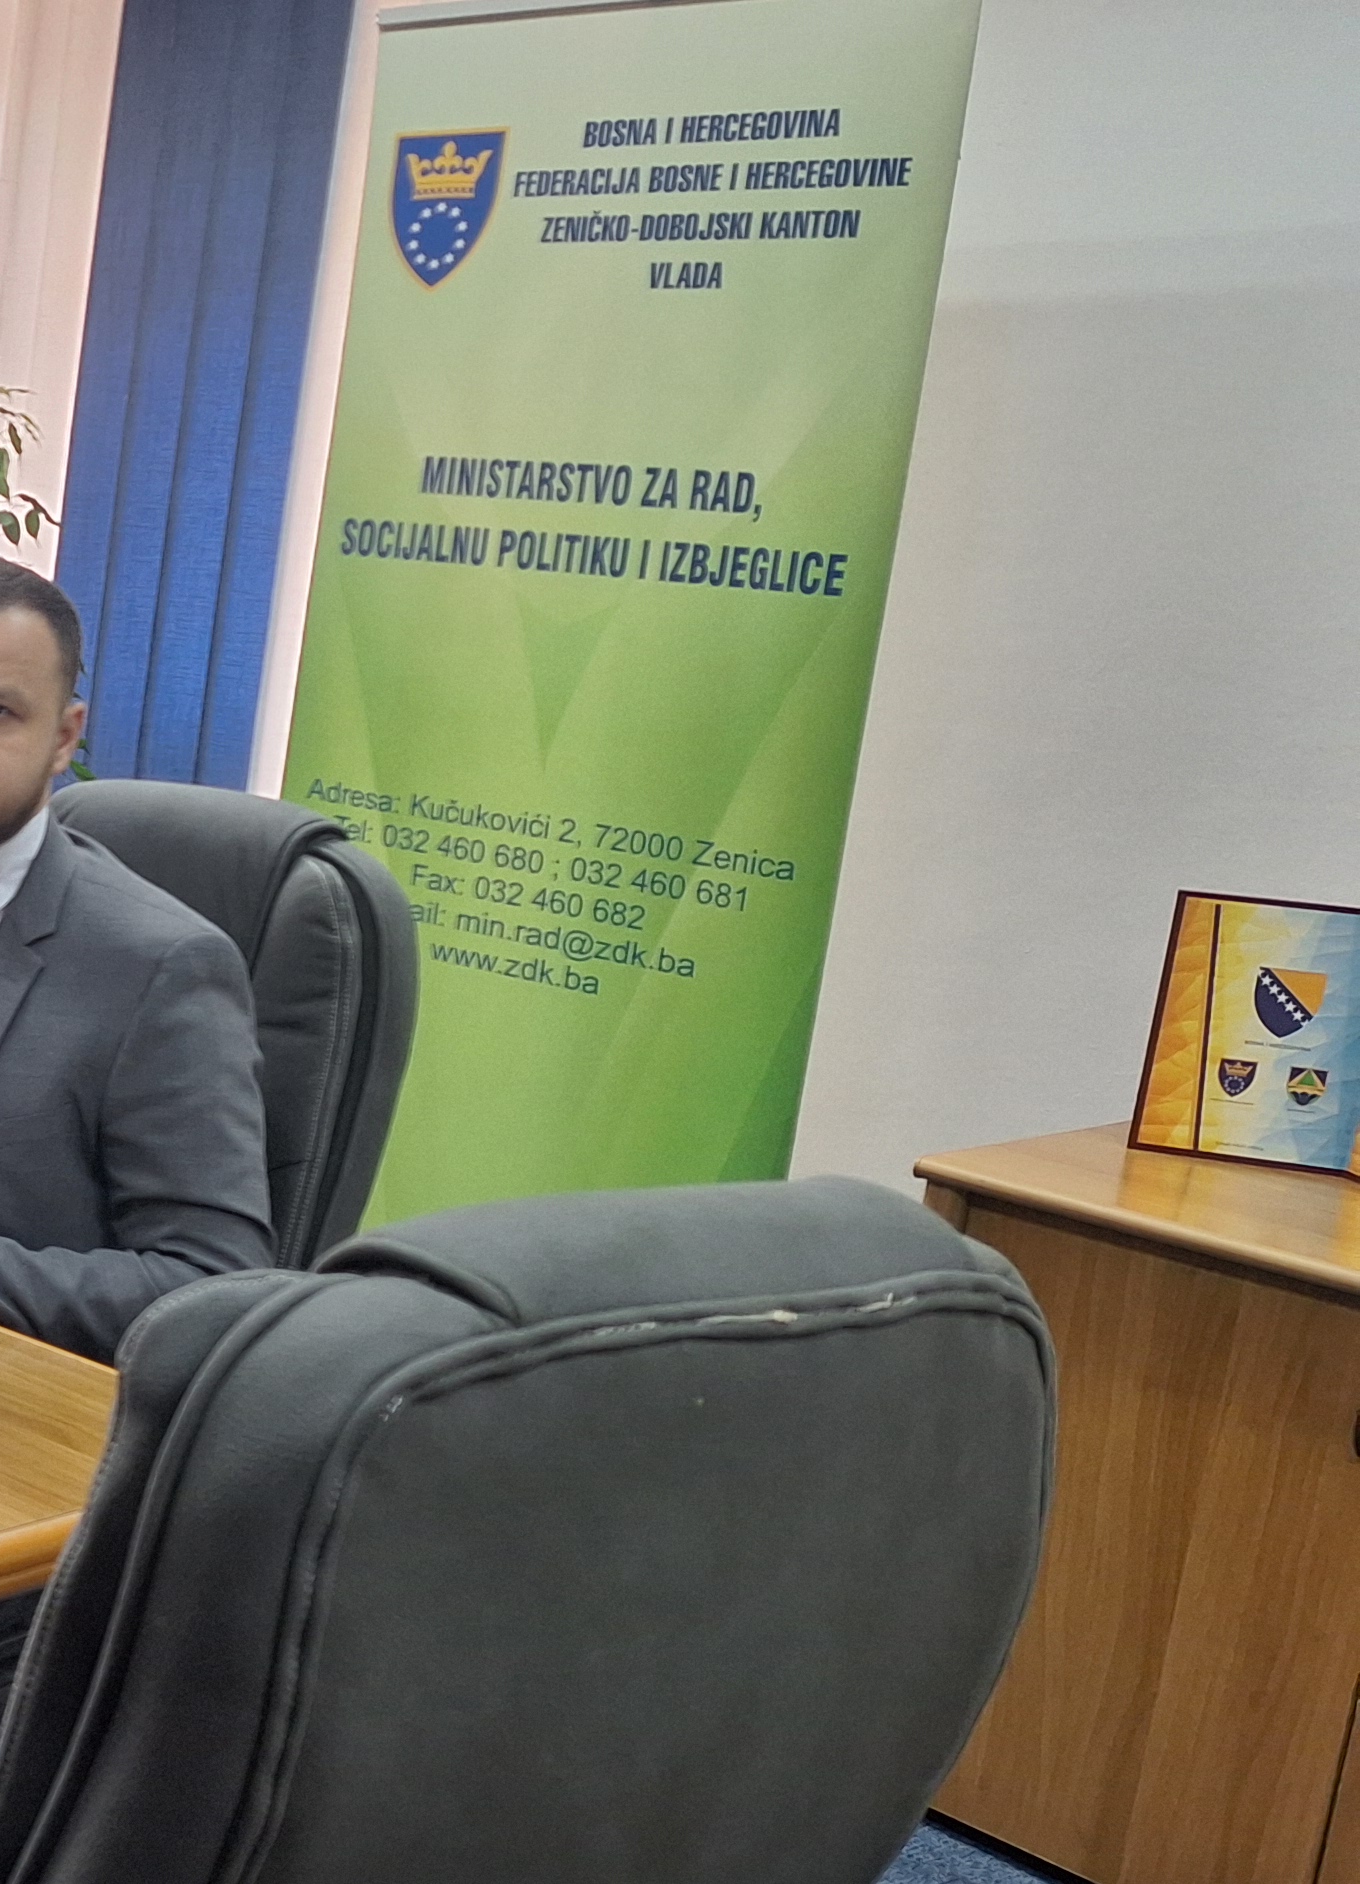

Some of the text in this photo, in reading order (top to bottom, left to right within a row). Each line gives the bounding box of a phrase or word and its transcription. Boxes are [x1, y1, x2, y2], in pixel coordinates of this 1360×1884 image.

[583, 108, 840, 148] BOSNA I HERCEGOVINA
[514, 157, 912, 198] FEDERACIJA BOSNE I HERCEGOVINE
[540, 209, 861, 243] ZENIČKO-DOBOJSKI KANTON
[649, 261, 723, 289] VLADA
[420, 456, 763, 523] MINISTARSTVO ZA RAD,
[340, 517, 849, 597] SOCIJALNU POLITIKU I IZBJEGLICE
[307, 778, 795, 881] Adresa: Kučukovići 2, 72000 Zenica
[383, 824, 430, 854] 032
[437, 835, 486, 863] 460
[495, 843, 544, 874] 680
[571, 857, 623, 889] 032
[631, 868, 686, 900] 460
[696, 879, 748, 912] 681
[410, 863, 646, 930] Fax: 032 460 682
[409, 902, 696, 978] ail: min.rad@zdk.ba
[431, 942, 599, 996] www.zdk.ba
